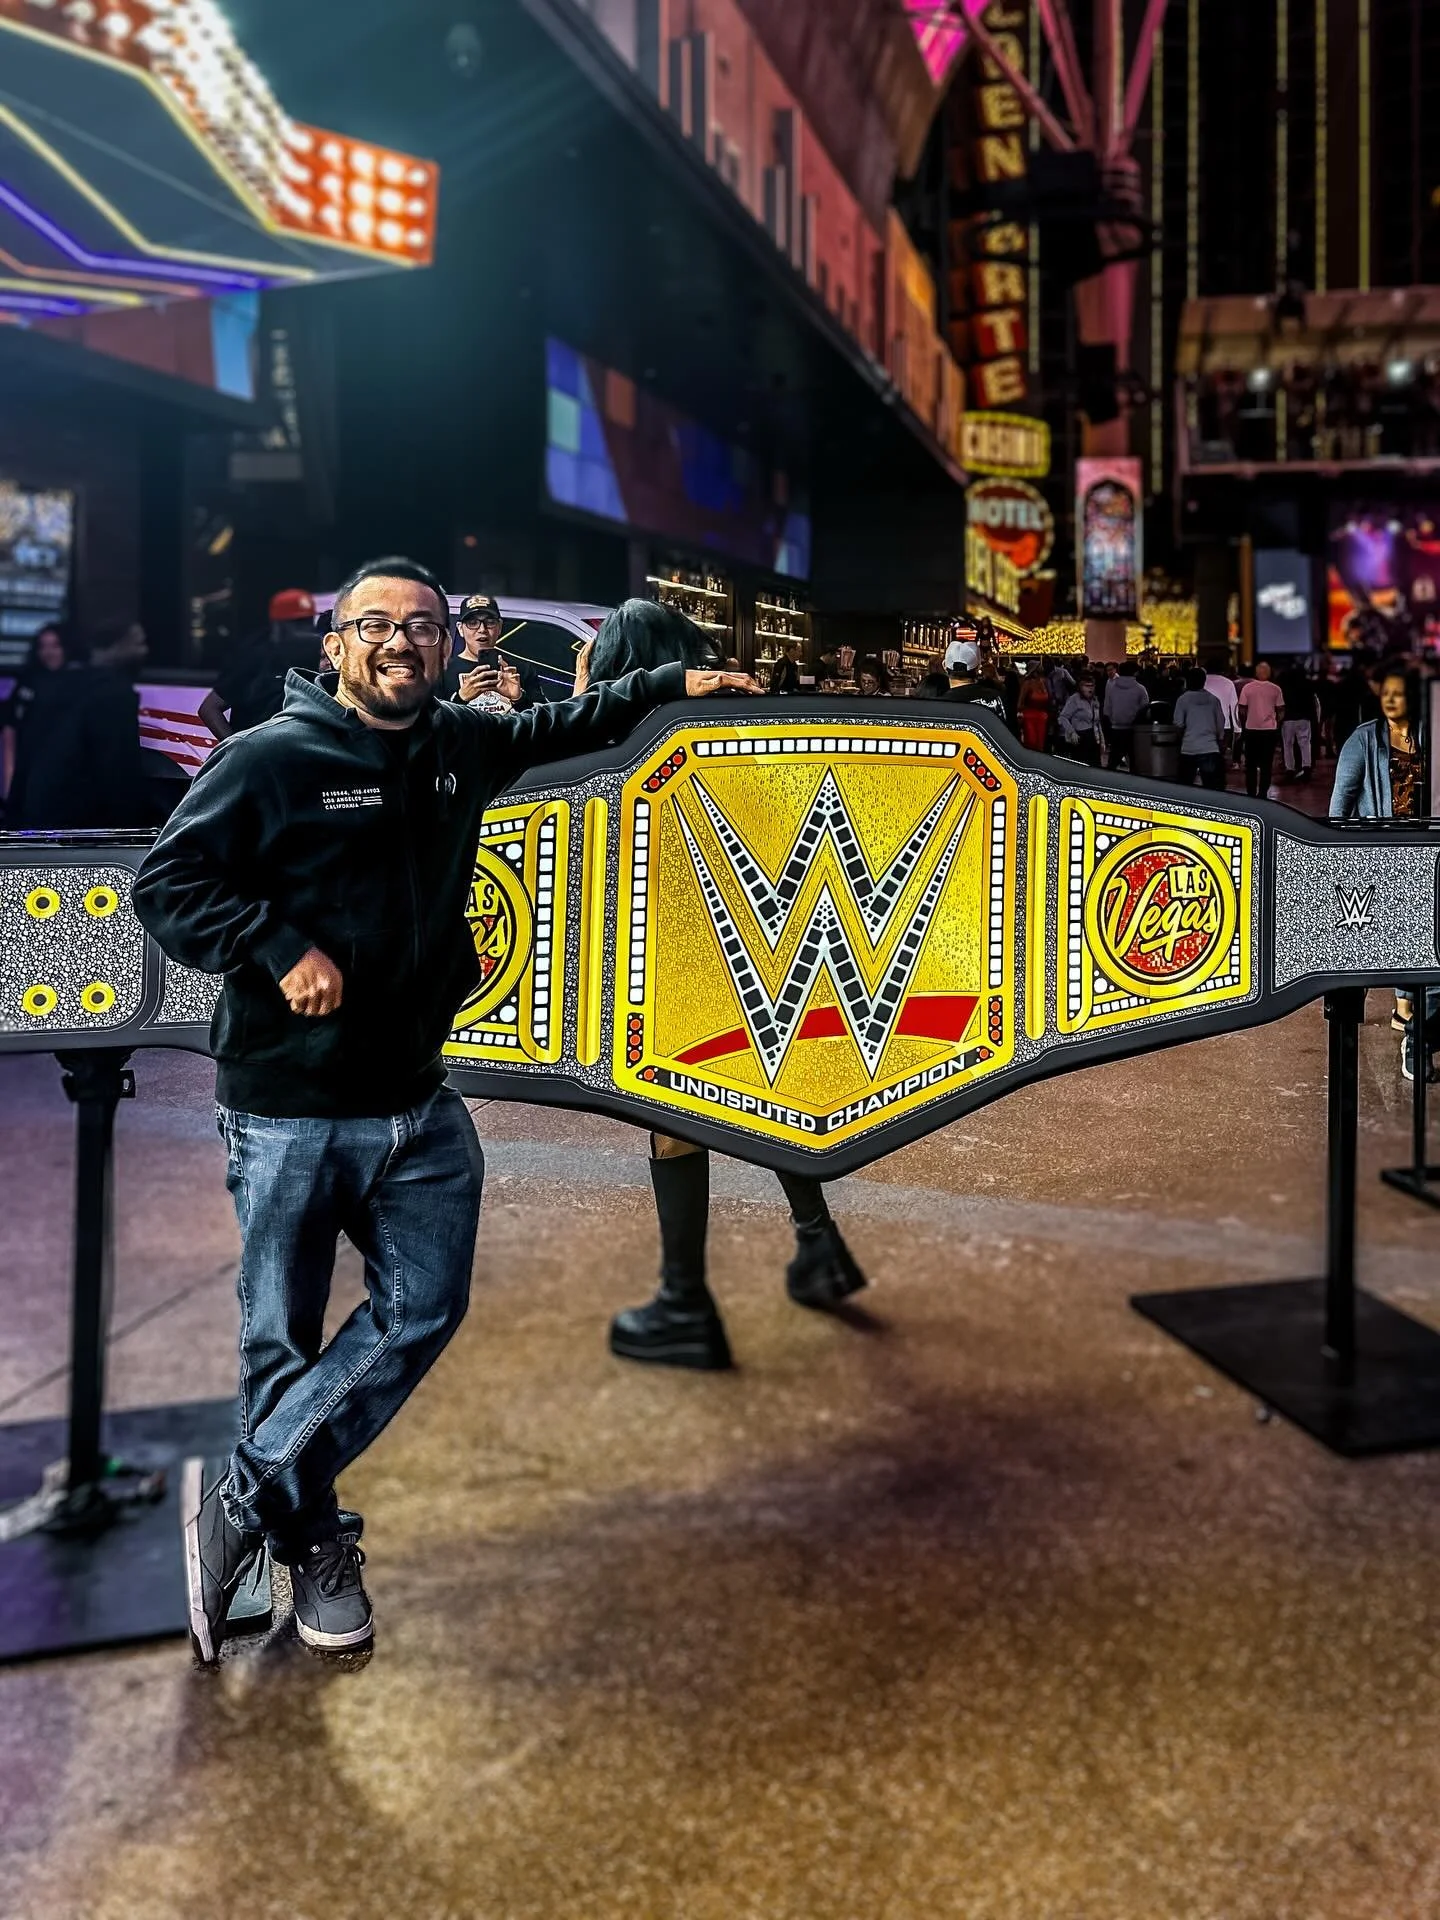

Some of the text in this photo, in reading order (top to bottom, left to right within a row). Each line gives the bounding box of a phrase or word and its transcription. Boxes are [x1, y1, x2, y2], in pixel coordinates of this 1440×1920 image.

[1106, 872, 1218, 962] Vegas
[1171, 868, 1209, 895] LAS
[670, 1055, 967, 1133] UNDISPUTED CHAMPION
